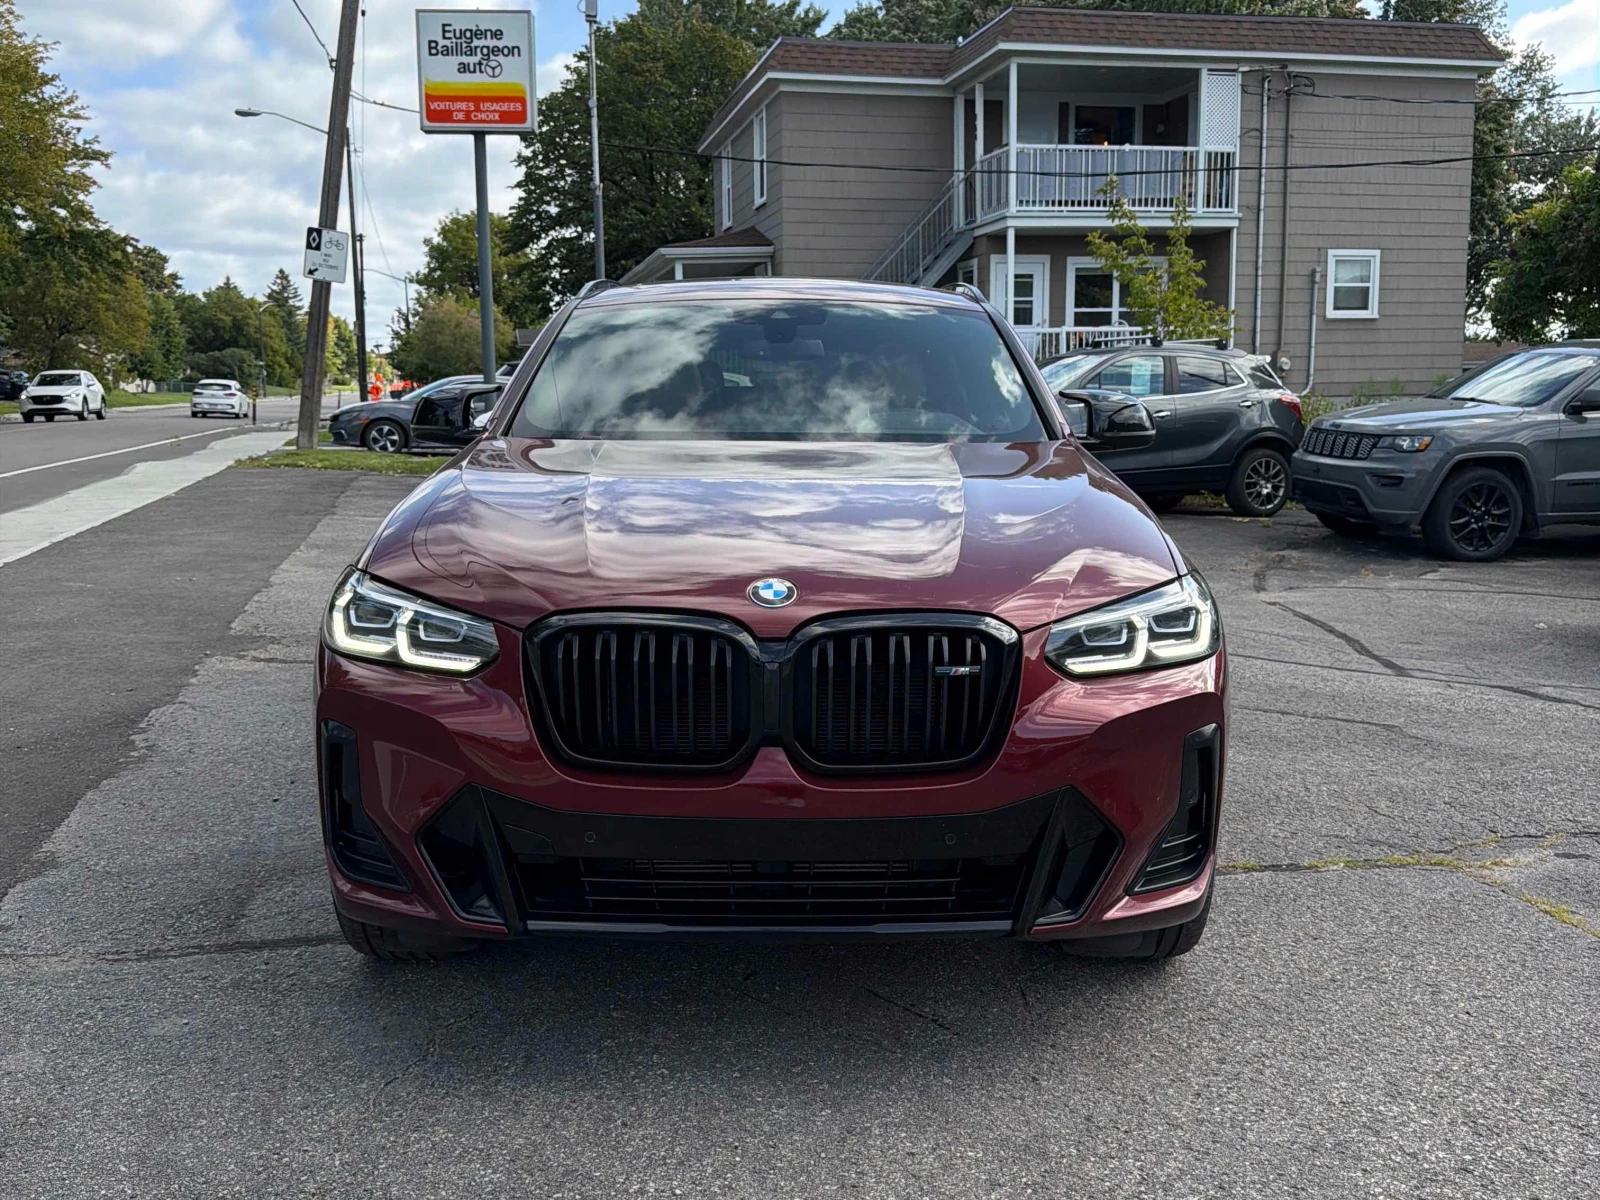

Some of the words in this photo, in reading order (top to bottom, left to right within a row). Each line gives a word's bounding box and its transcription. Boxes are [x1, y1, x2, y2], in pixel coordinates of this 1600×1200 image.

[442, 23, 504, 45] Eugène
[428, 40, 521, 61] Baillargeon
[429, 101, 475, 111] VOITURES
[453, 112, 465, 120] DE
[471, 112, 500, 120] CHOIX
